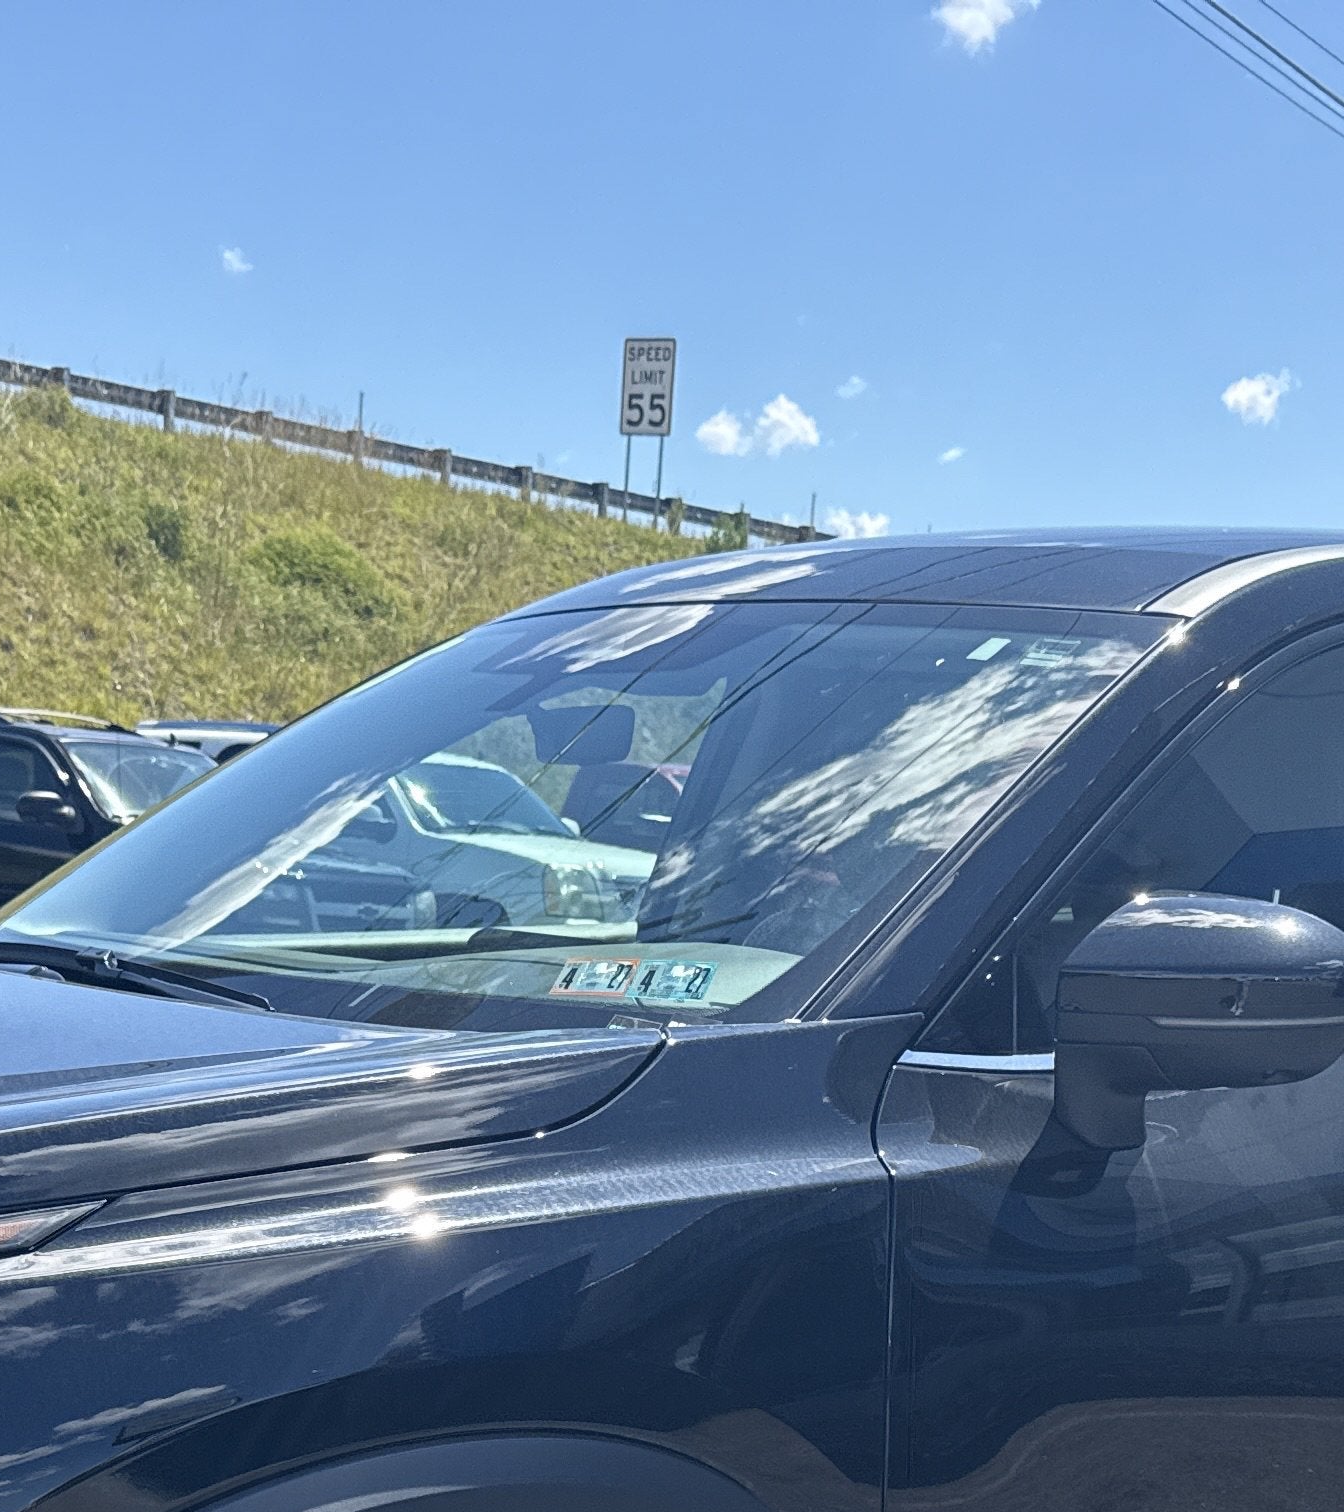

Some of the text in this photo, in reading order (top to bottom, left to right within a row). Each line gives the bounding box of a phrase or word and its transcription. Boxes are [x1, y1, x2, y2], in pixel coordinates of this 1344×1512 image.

[627, 346, 672, 362] SPEED
[631, 370, 666, 385] LIMIT
[626, 393, 666, 427] 55
[561, 963, 633, 991] 4 27
[639, 969, 657, 993] 4
